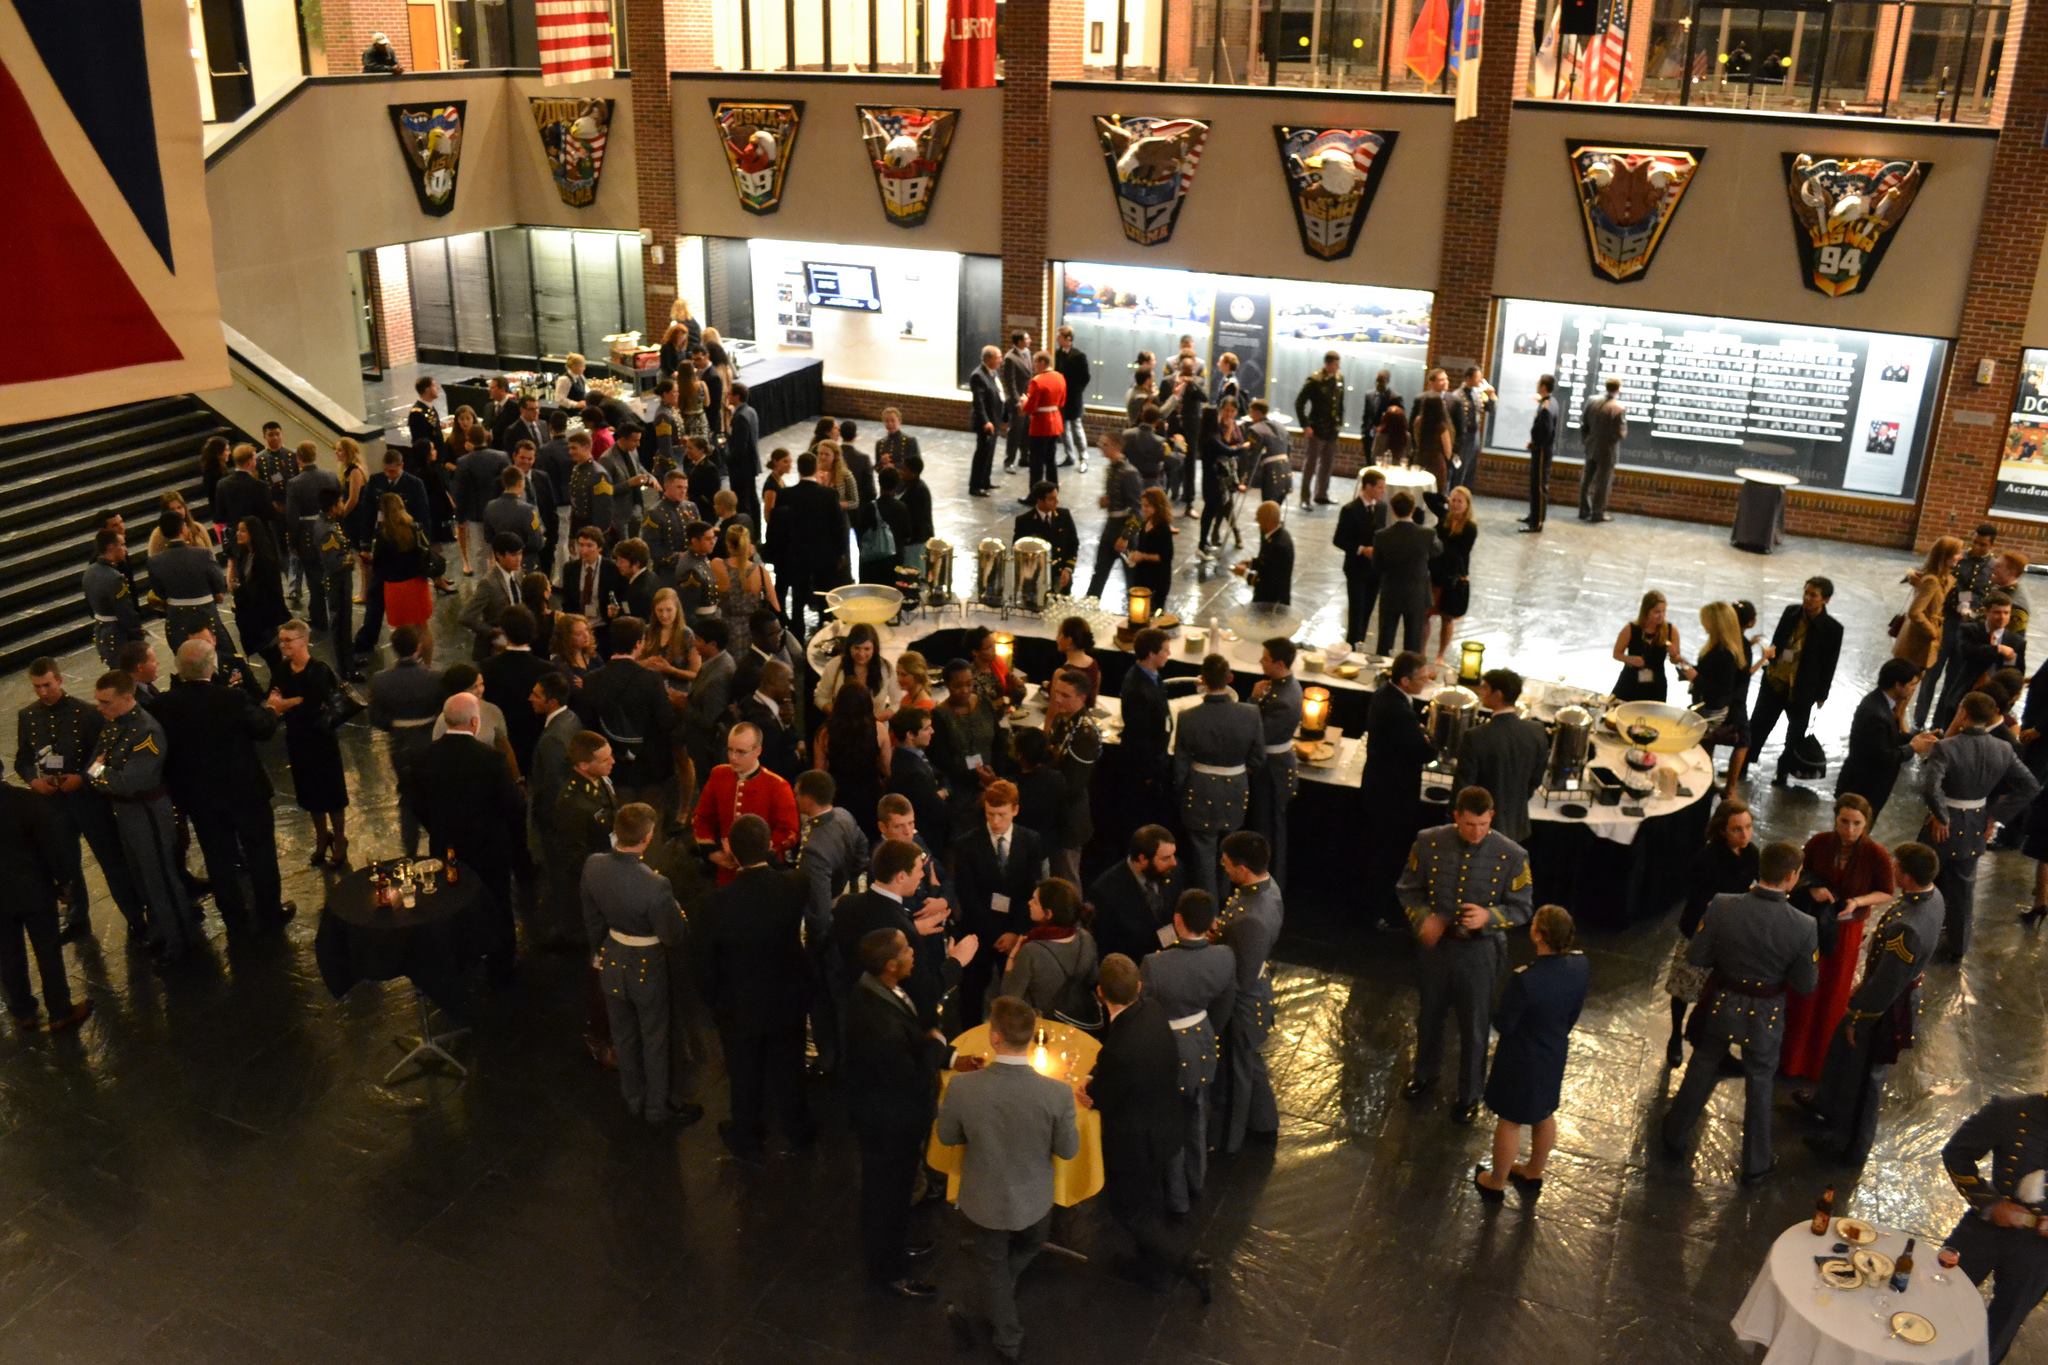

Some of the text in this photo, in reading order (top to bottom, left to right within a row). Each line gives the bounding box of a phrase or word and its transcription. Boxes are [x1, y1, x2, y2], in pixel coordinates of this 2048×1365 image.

[880, 175, 930, 206] 98
[1118, 195, 1176, 235] 97
[1302, 210, 1355, 247] 96
[1597, 226, 1652, 262] 95
[1818, 245, 1862, 277] 94
[2022, 395, 2048, 414] DC
